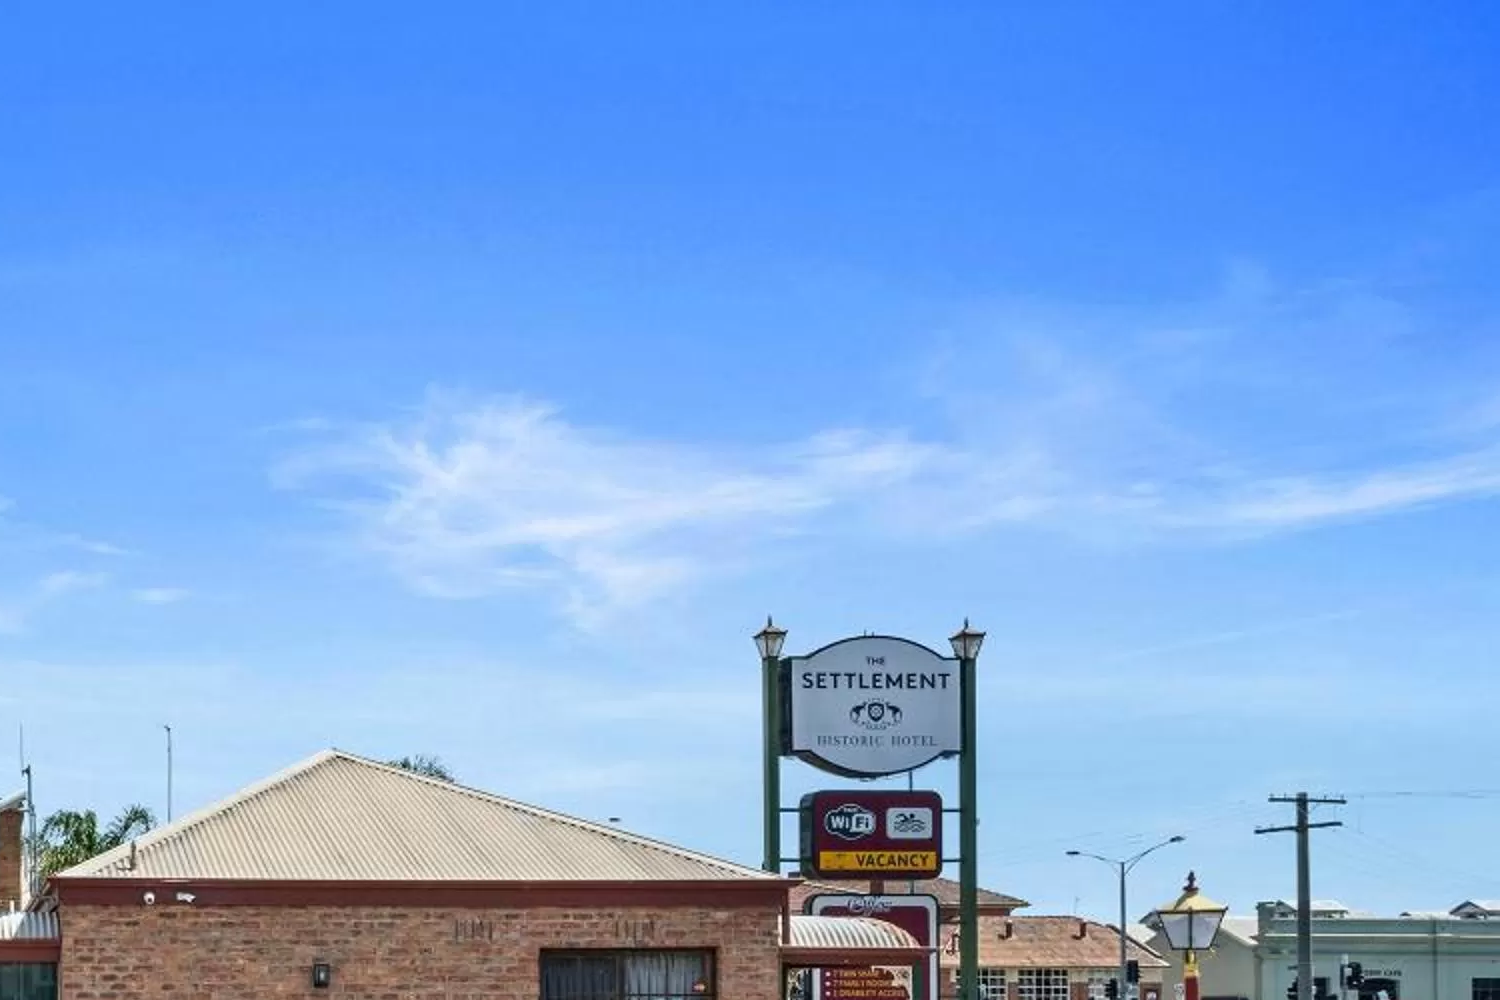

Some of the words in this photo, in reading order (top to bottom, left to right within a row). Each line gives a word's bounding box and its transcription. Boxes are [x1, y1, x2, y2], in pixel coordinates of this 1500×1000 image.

[865, 655, 886, 666] THE
[801, 671, 952, 690] SETTLEMENT
[817, 735, 884, 747] HISTORIC
[891, 735, 939, 747] HOTEL
[855, 853, 930, 868] VACANCY
